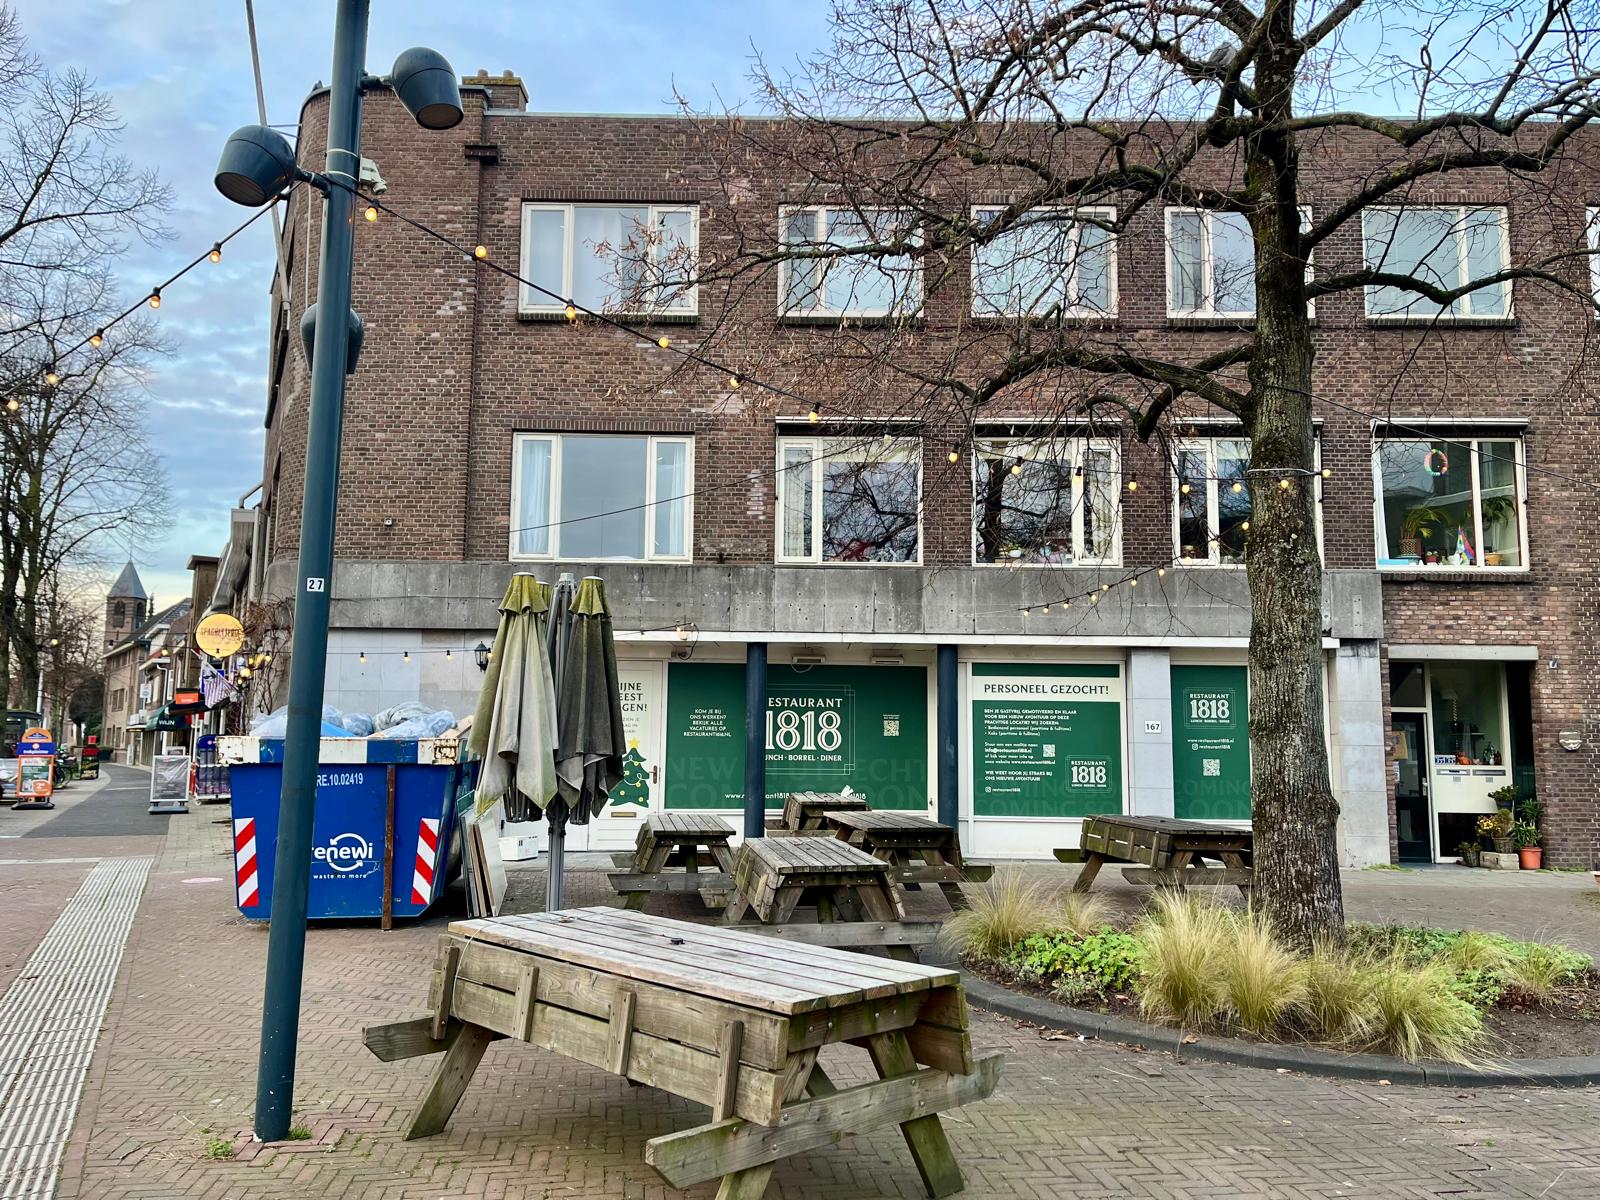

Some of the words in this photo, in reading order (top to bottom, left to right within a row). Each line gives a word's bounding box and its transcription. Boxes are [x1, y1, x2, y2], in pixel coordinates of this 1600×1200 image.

[309, 579, 323, 590] 27
[620, 682, 642, 691] IJNE
[984, 684, 1048, 694] PERSONEEL
[1050, 685, 1109, 695] GEZOCHT!
[619, 693, 643, 701] EEST
[768, 697, 843, 708] ESTAURANT
[622, 703, 647, 712] GEN!
[1190, 699, 1230, 719] 1818
[765, 710, 842, 751] 1818
[1146, 723, 1160, 731] 167
[788, 754, 816, 762] BORREL
[1071, 766, 1107, 783] 1818
[311, 843, 373, 859] enewi
